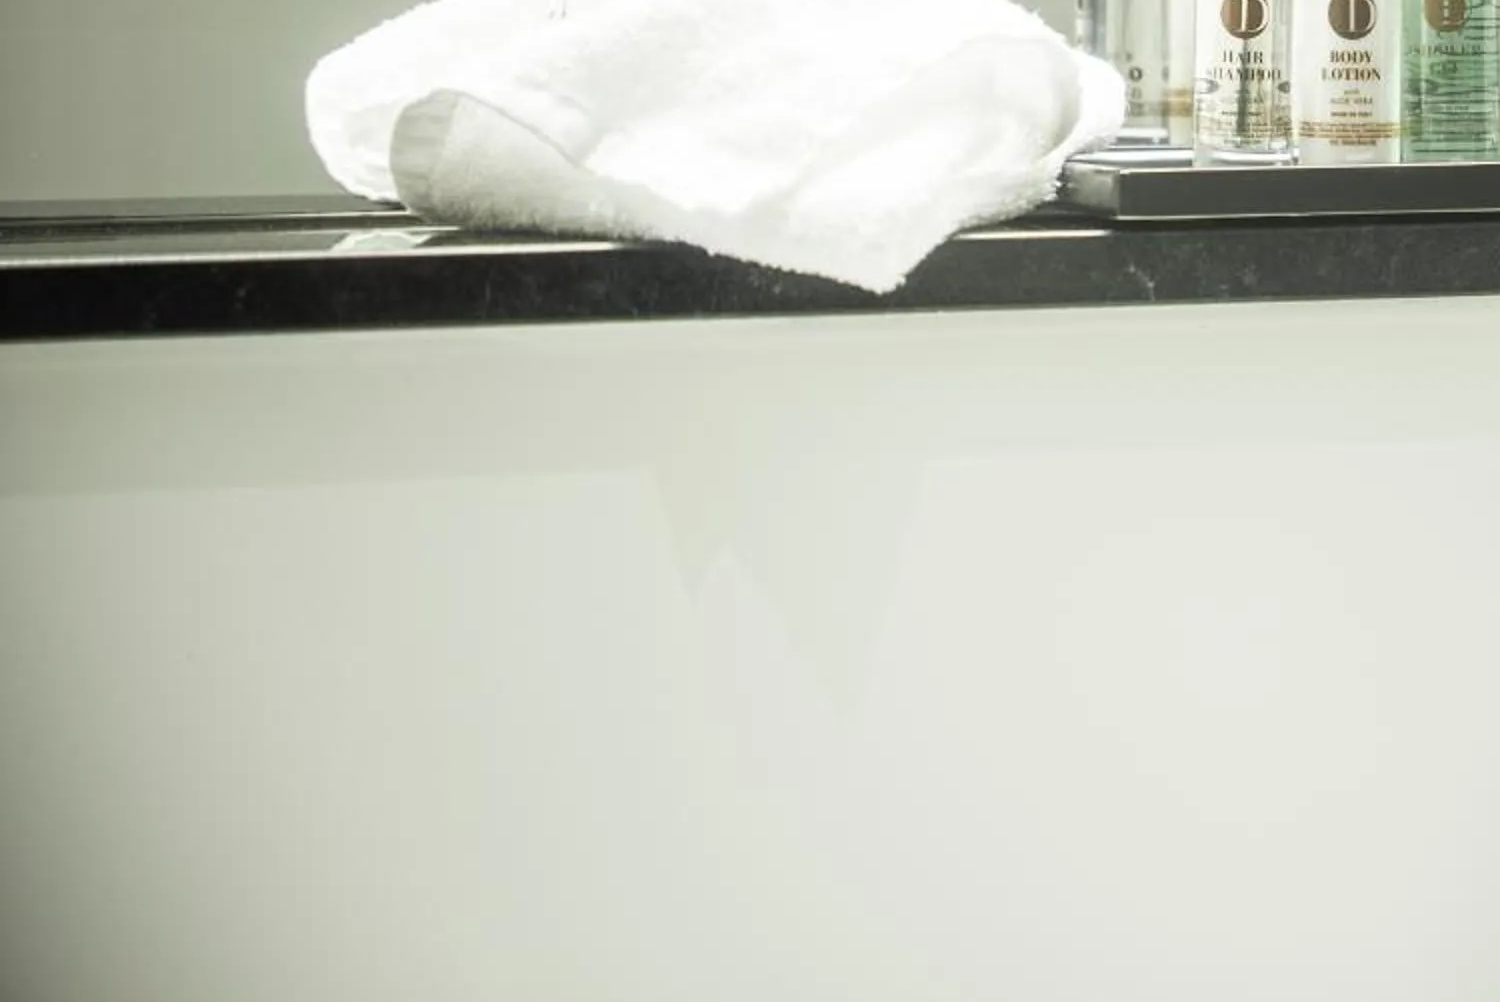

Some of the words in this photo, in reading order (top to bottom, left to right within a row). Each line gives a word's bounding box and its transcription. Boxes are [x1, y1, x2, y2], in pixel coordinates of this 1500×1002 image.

[1221, 49, 1264, 64] HAIR
[1328, 49, 1374, 64] BODY
[1320, 67, 1382, 82] LOTION
